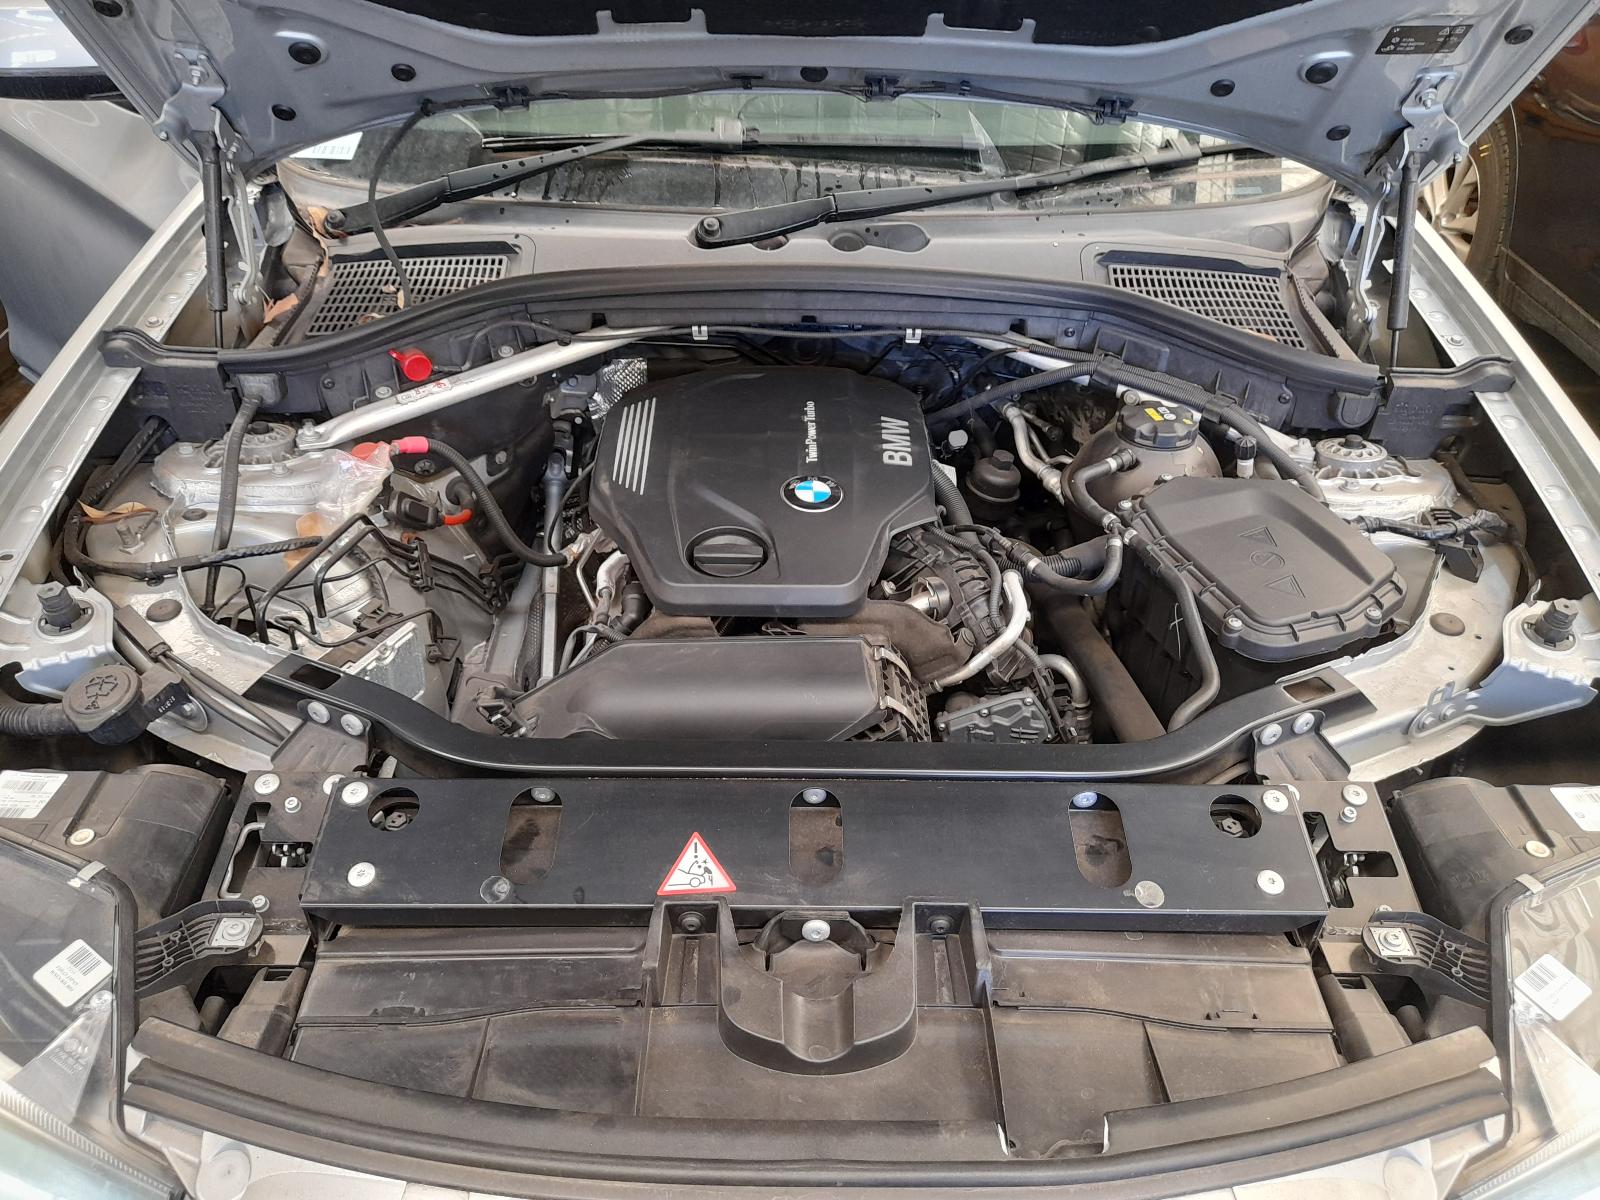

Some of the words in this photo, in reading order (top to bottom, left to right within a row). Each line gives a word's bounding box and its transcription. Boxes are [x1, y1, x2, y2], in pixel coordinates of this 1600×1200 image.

[804, 401, 815, 421] Turbo
[805, 421, 818, 464] TwinPower
[880, 416, 913, 467] BMW
